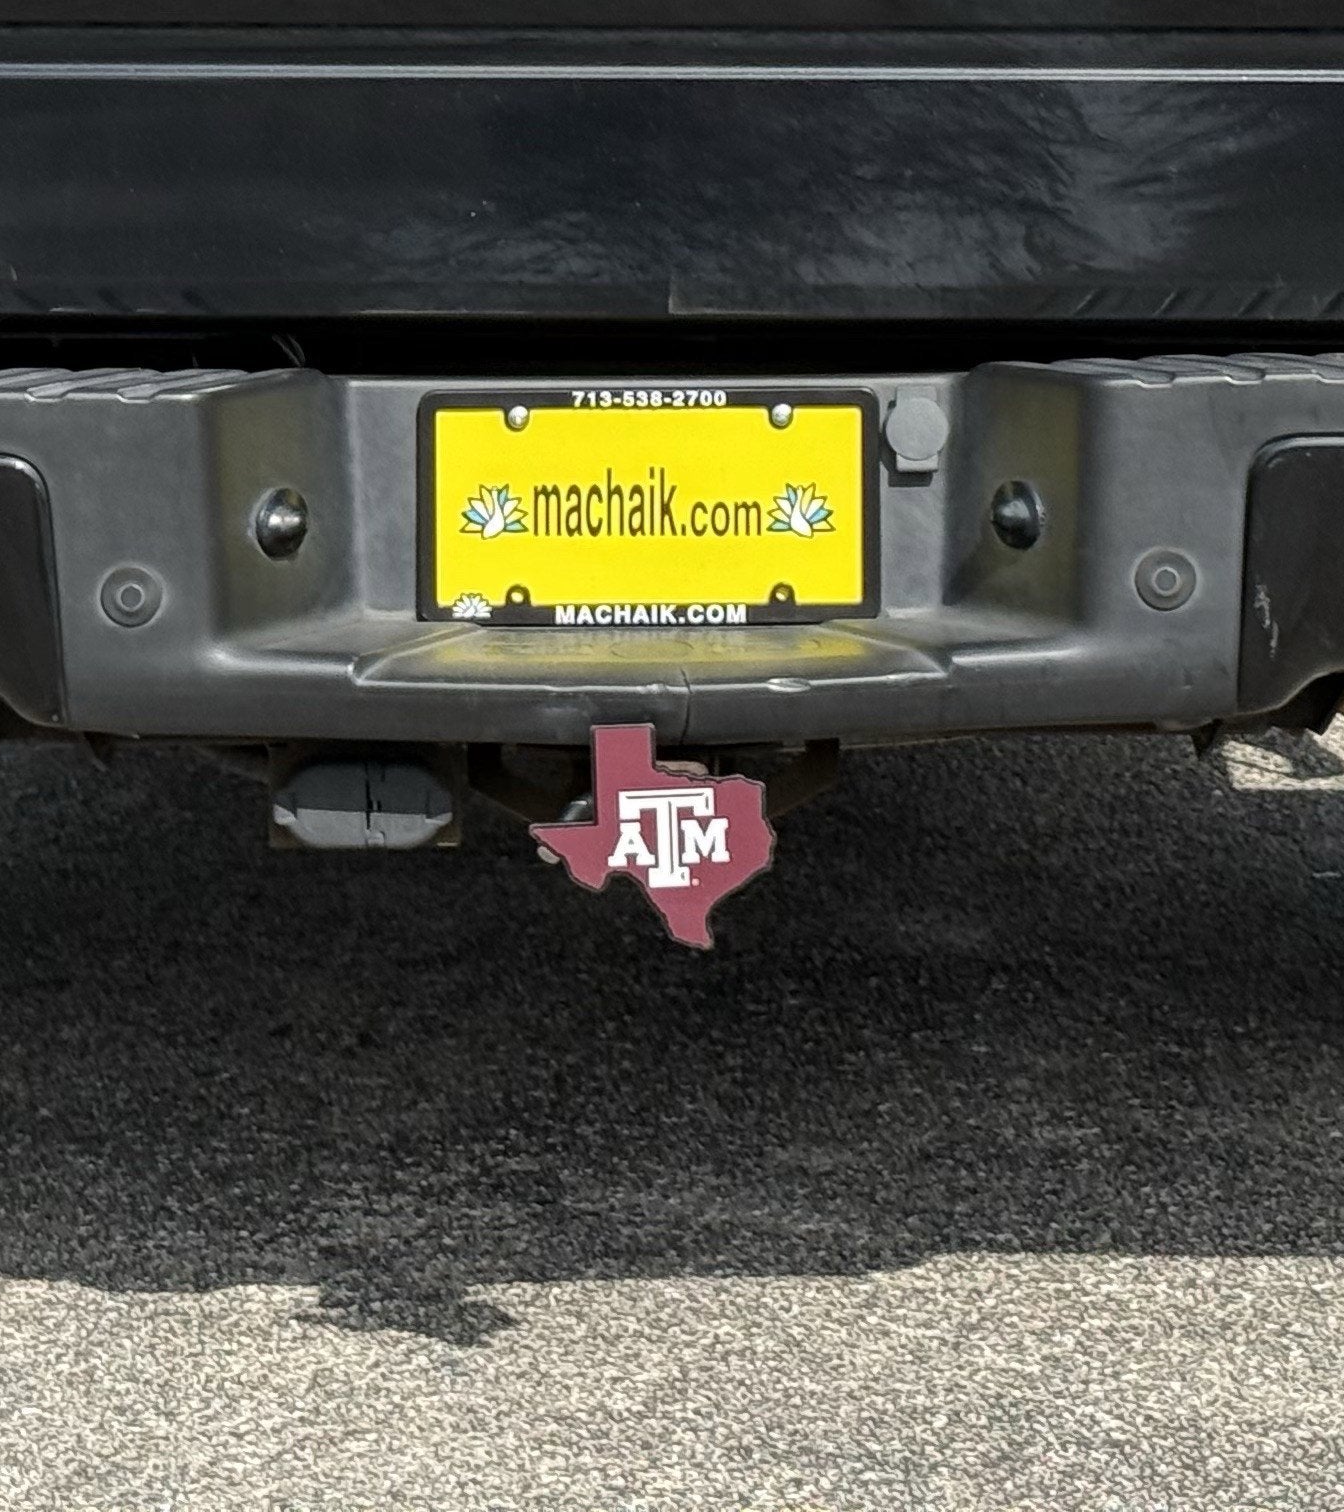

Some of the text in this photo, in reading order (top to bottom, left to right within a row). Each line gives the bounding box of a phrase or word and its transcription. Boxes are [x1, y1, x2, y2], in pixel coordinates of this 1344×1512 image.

[571, 390, 727, 408] 713-538-2700
[533, 467, 762, 537] machaik.com
[555, 604, 747, 625] MACHAIK.COM
